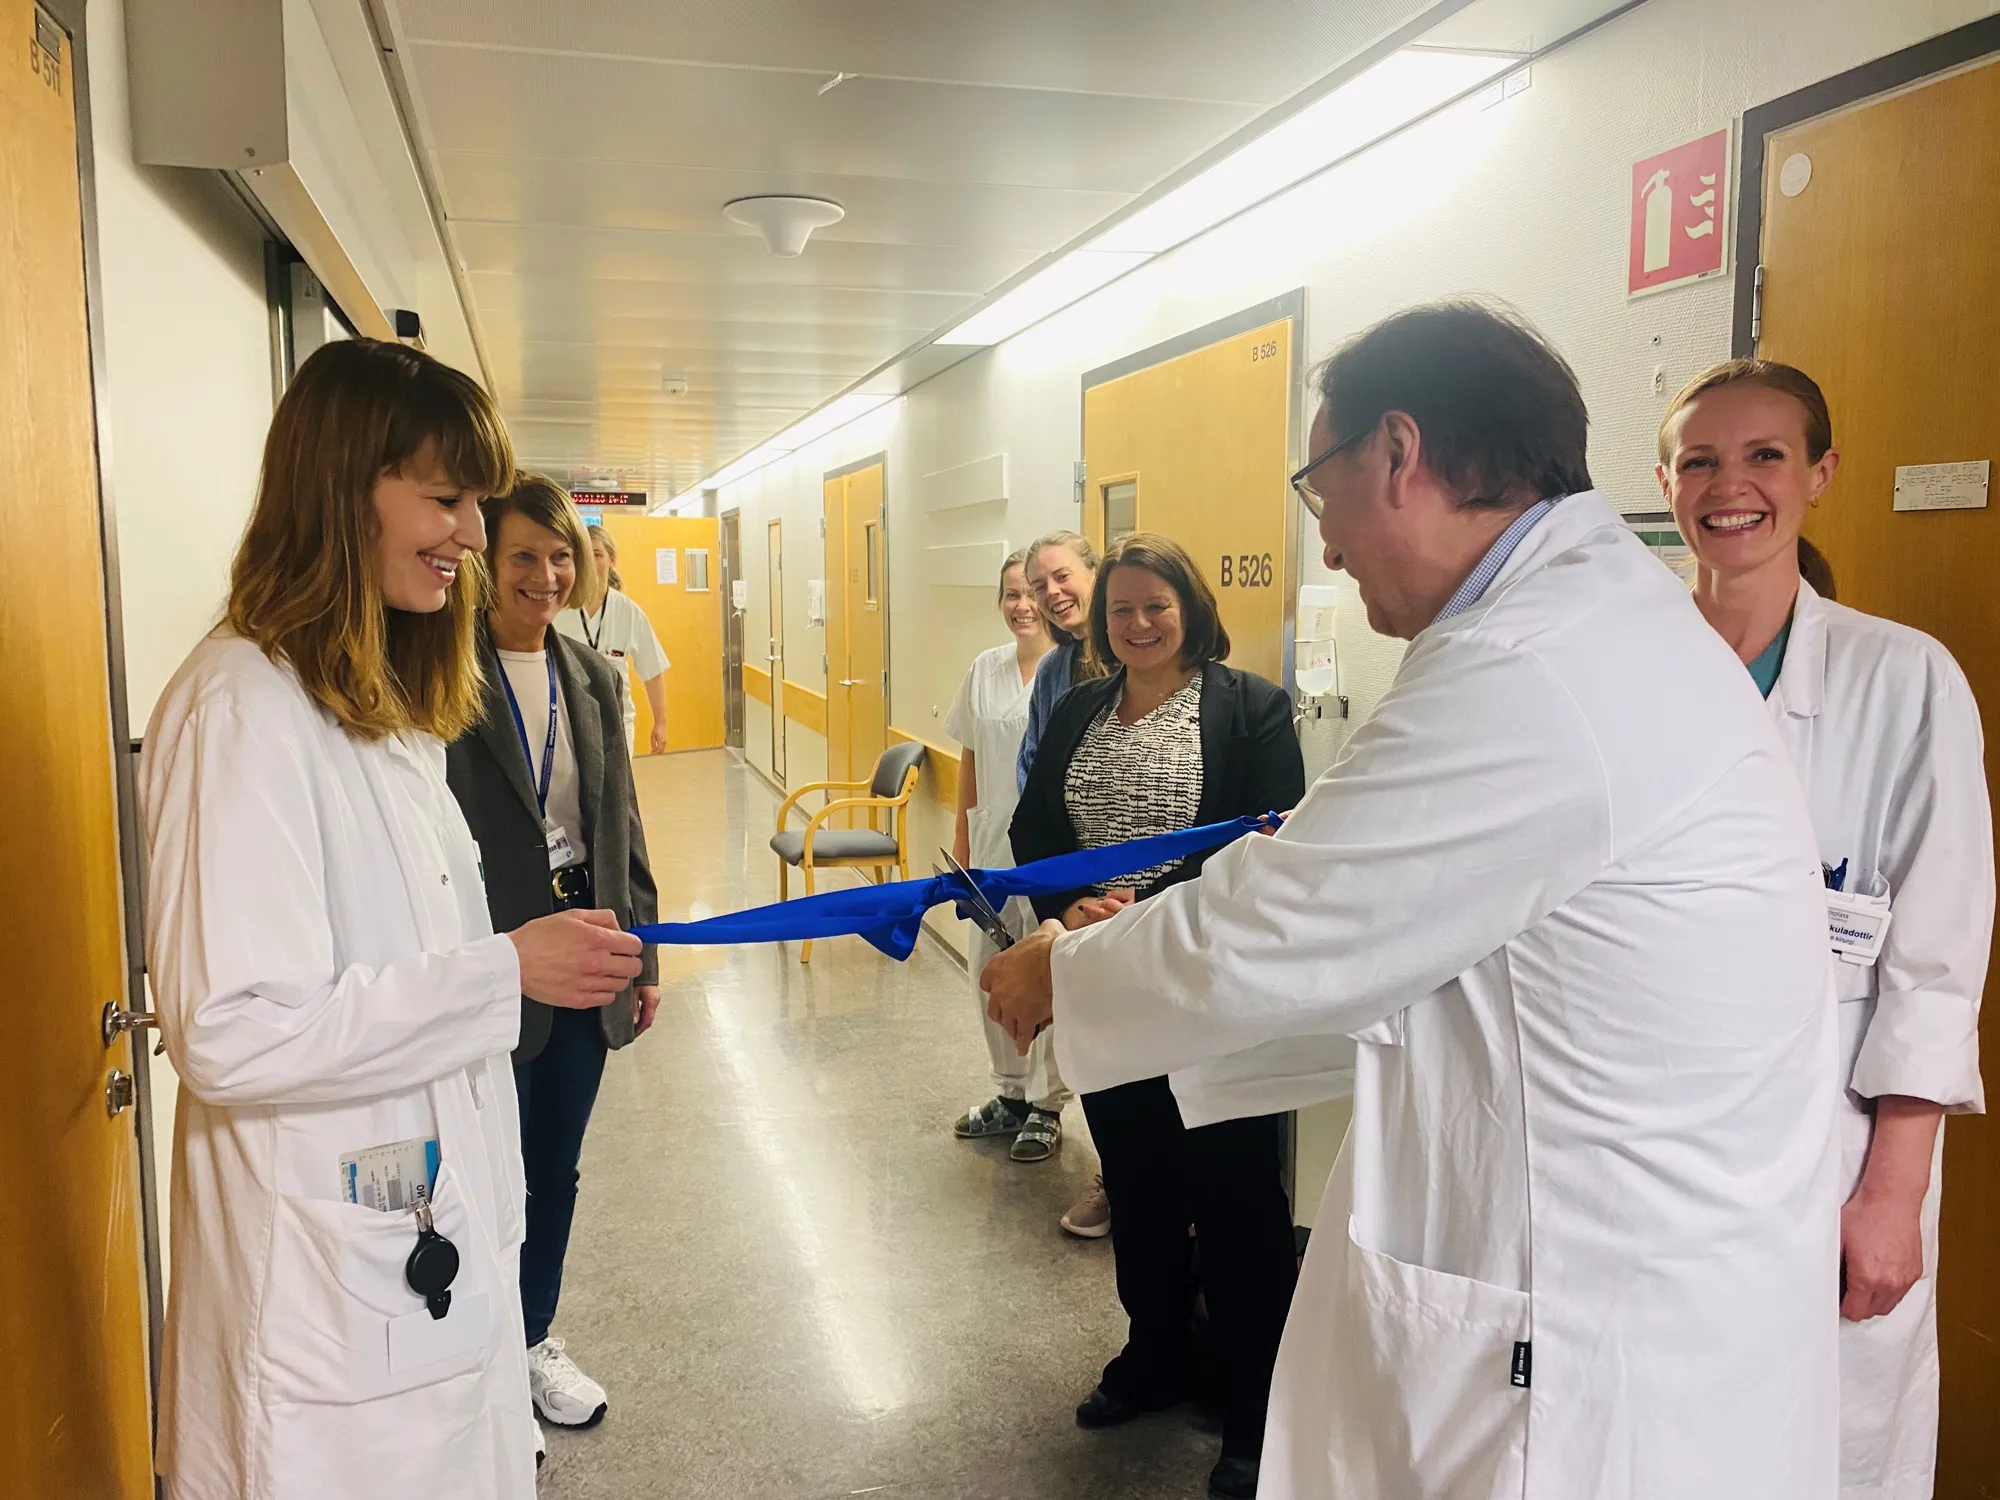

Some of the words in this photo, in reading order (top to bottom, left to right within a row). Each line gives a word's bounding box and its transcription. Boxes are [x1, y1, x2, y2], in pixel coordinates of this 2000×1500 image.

[29, 36, 40, 75] B
[43, 51, 62, 98] 511
[1252, 346, 1259, 362] B
[1260, 340, 1277, 360] 526
[1221, 555, 1233, 587] B
[1238, 552, 1273, 588] 526
[1829, 924, 1873, 940] kuladottir
